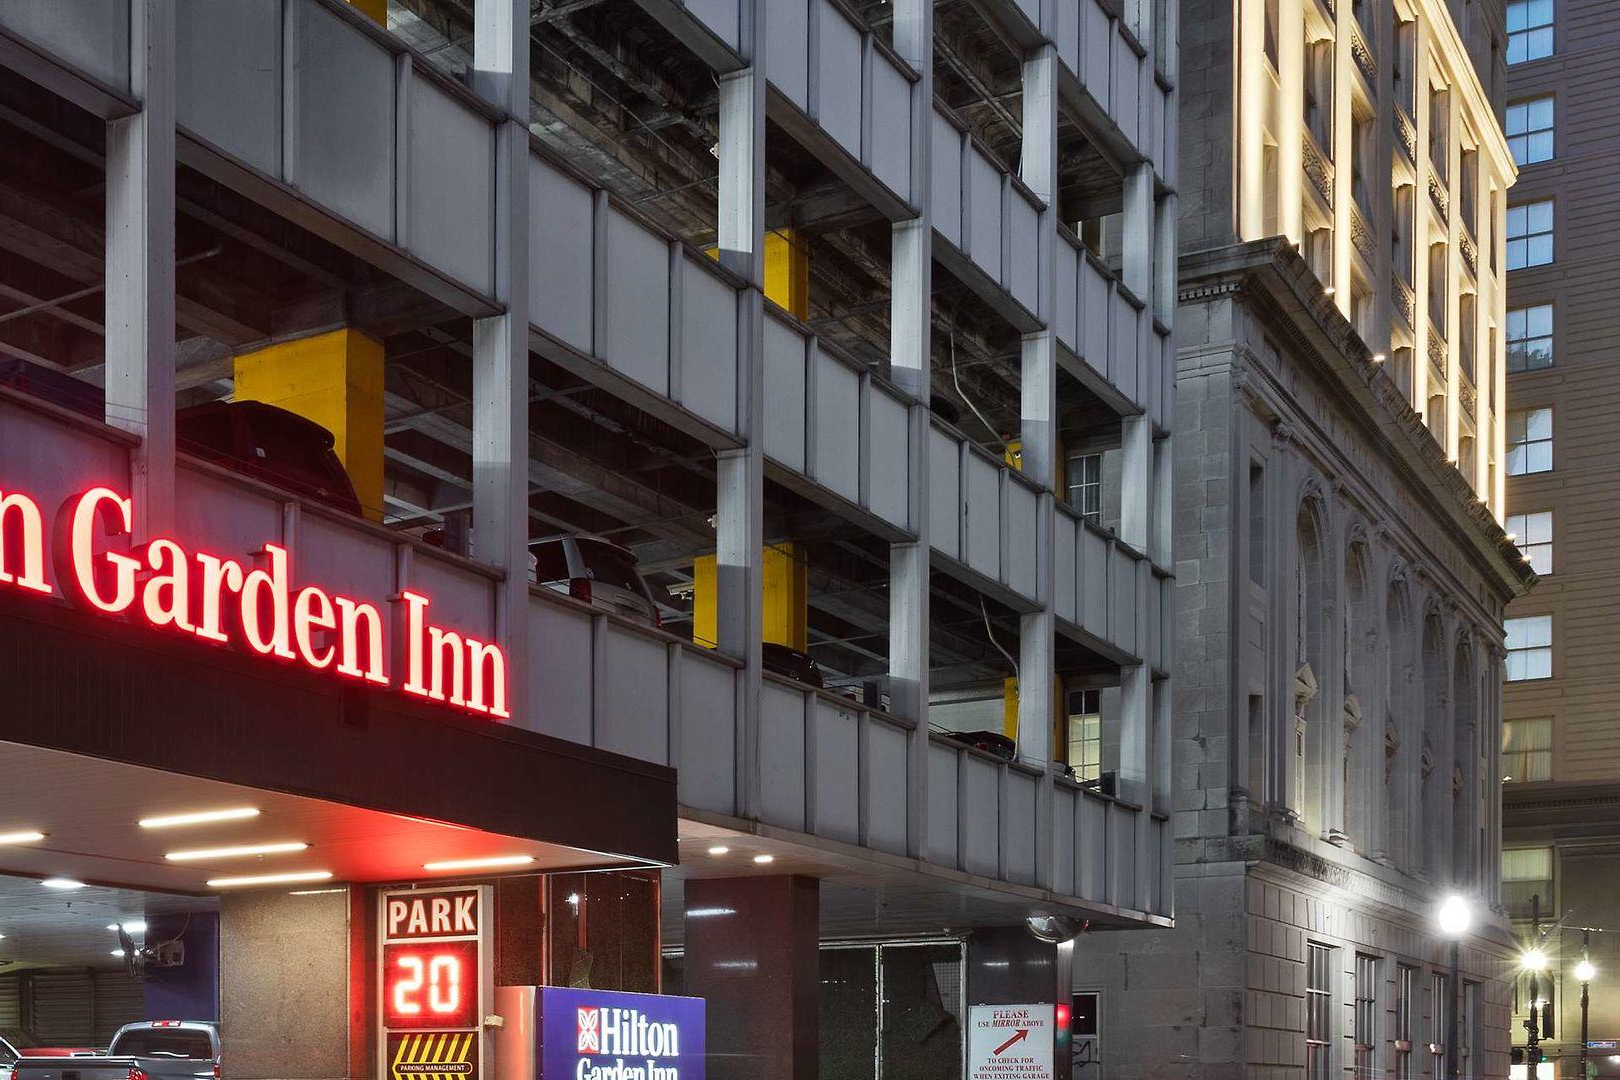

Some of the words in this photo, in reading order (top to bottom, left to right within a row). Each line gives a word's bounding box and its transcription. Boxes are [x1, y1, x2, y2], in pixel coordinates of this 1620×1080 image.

[71, 486, 390, 684] Garden
[402, 591, 511, 720] Inn
[389, 896, 477, 935] PARK
[394, 955, 459, 1014] 20
[978, 1020, 990, 1028] USE
[991, 1019, 1021, 1028] MIRROR
[993, 1010, 1029, 1019] PLEASE
[600, 1008, 679, 1057] Hilton
[400, 1064, 424, 1072] PARKING
[425, 1064, 465, 1072] MANAGEMENT
[994, 1072, 1021, 1080] EXITING
[1022, 1072, 1050, 1080] GARAGE
